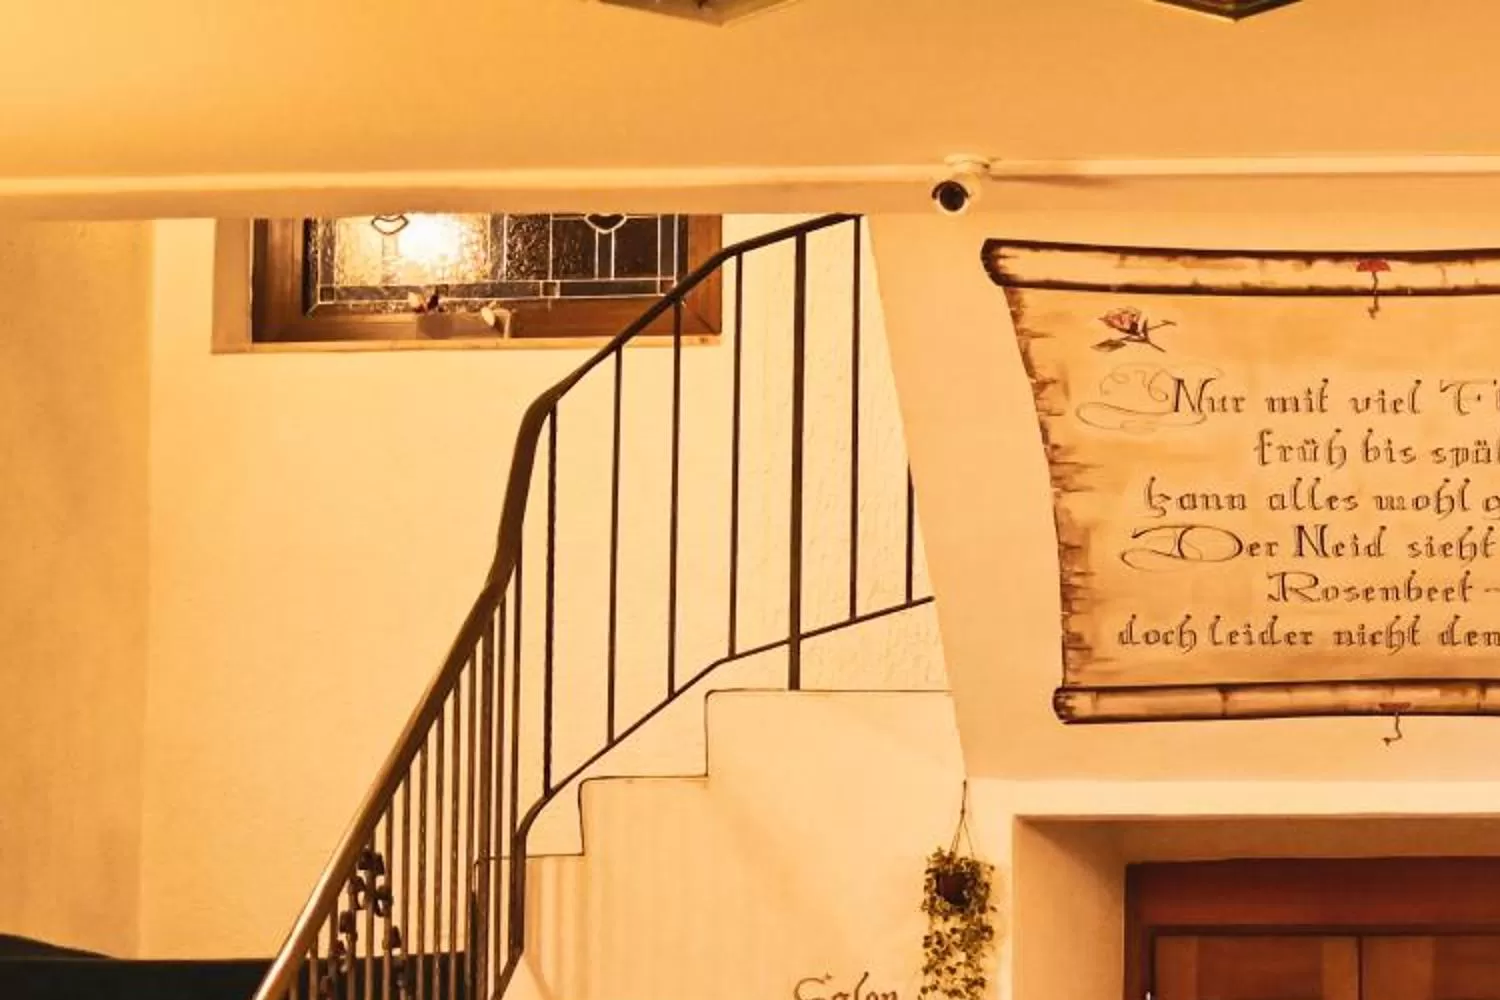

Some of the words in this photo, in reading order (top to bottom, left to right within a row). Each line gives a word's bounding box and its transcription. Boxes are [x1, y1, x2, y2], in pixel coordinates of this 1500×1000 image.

[1265, 377, 1329, 414] mit
[1350, 379, 1421, 414] viel
[1253, 428, 1347, 469] früh
[1362, 428, 1417, 464] bis
[1144, 476, 1247, 518] kann
[1269, 477, 1359, 511] alles
[1375, 477, 1471, 520] wohl
[1120, 524, 1280, 572] Der
[1294, 523, 1388, 558] Neid
[1407, 525, 1497, 565] sieht
[1266, 569, 1473, 602] Rosenbeet
[1117, 614, 1198, 654] doch
[1208, 614, 1314, 647] leider
[1333, 614, 1421, 655] nicht
